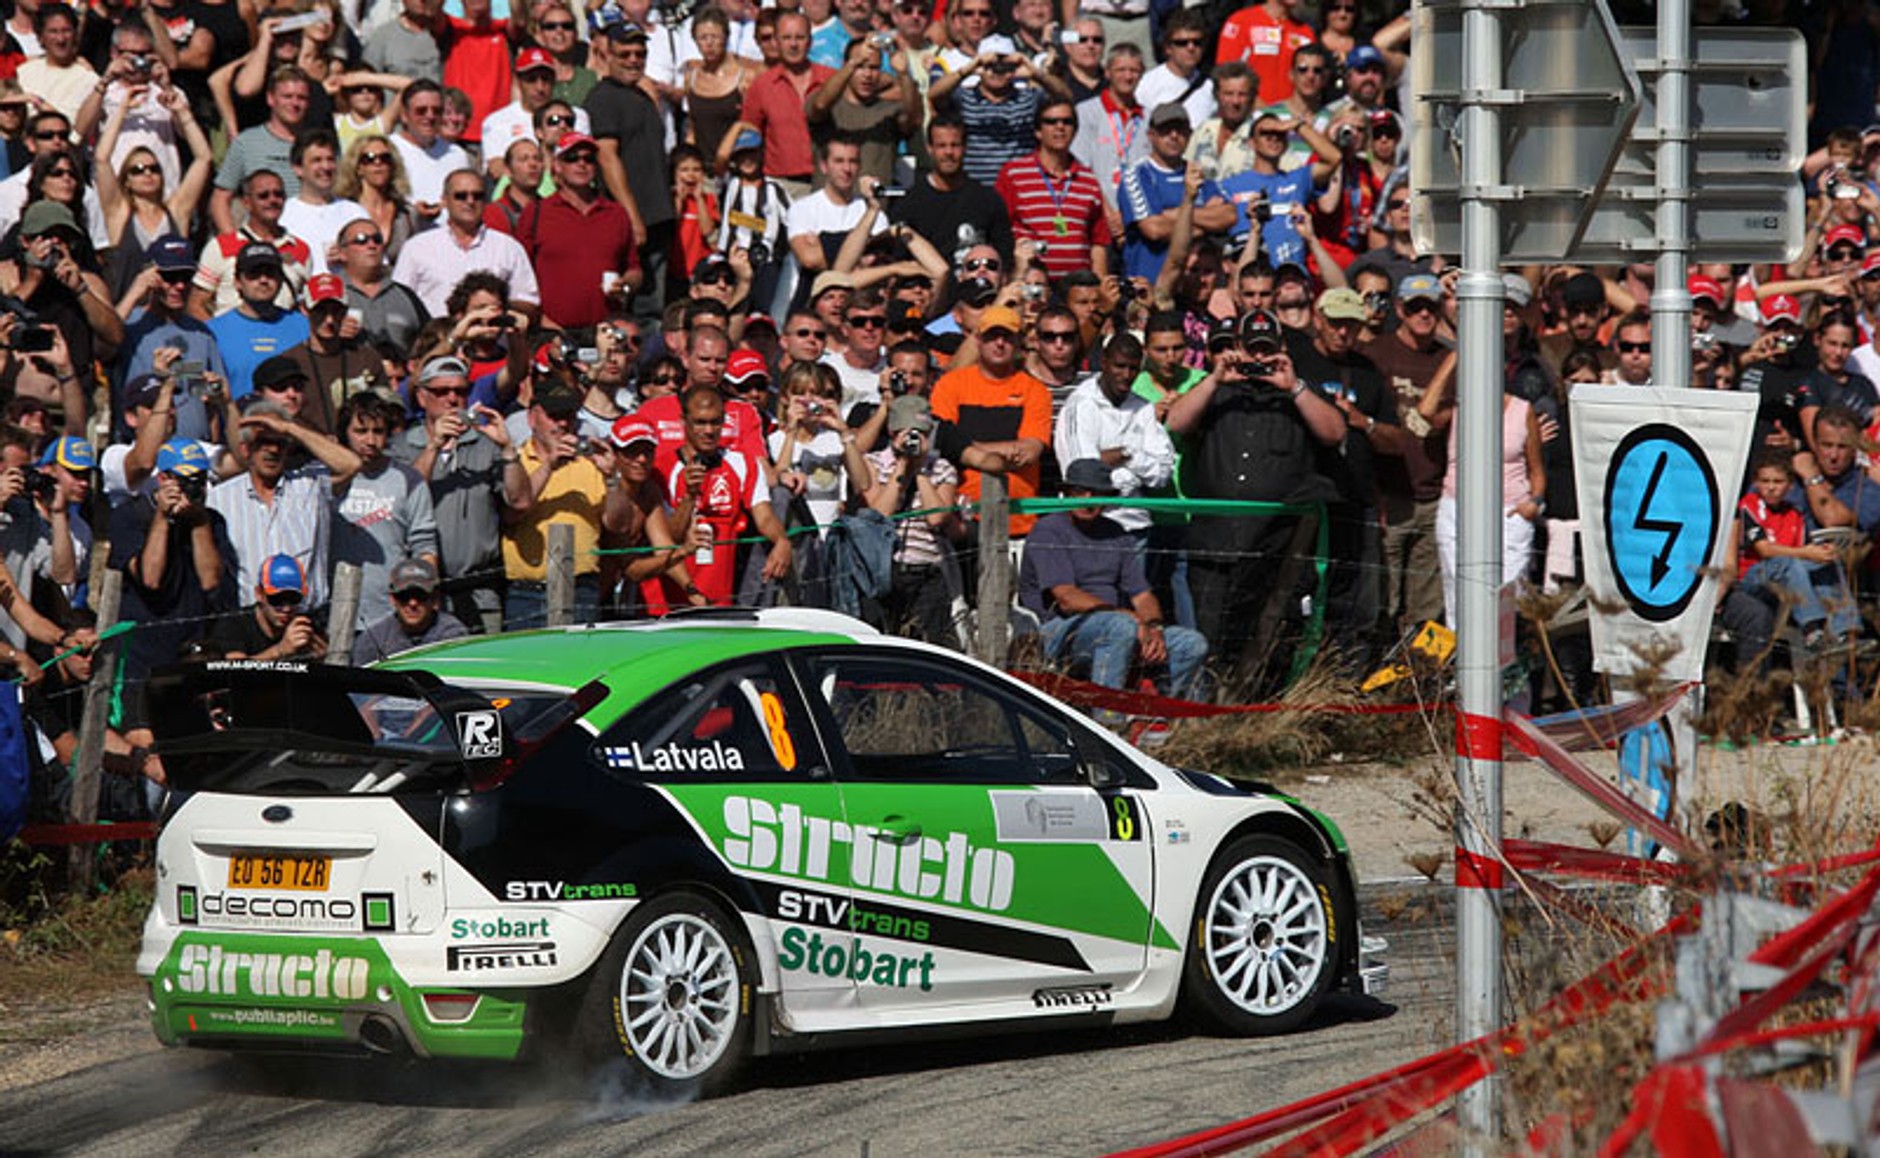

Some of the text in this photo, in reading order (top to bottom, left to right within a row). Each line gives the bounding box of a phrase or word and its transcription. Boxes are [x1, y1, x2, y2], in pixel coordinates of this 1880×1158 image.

[759, 692, 796, 771] 8
[631, 740, 744, 771] Latvala
[1113, 796, 1133, 841] 8
[260, 855, 283, 885] 56
[293, 857, 326, 887] TZR
[723, 795, 1015, 911] Structo
[202, 891, 356, 919] decomo
[505, 881, 638, 900] STVtrans
[451, 917, 549, 939] Stobart
[777, 890, 931, 941] STVtrans
[178, 943, 370, 1000] Structo
[446, 942, 557, 972] PIRELLI
[778, 926, 935, 992] Stobart
